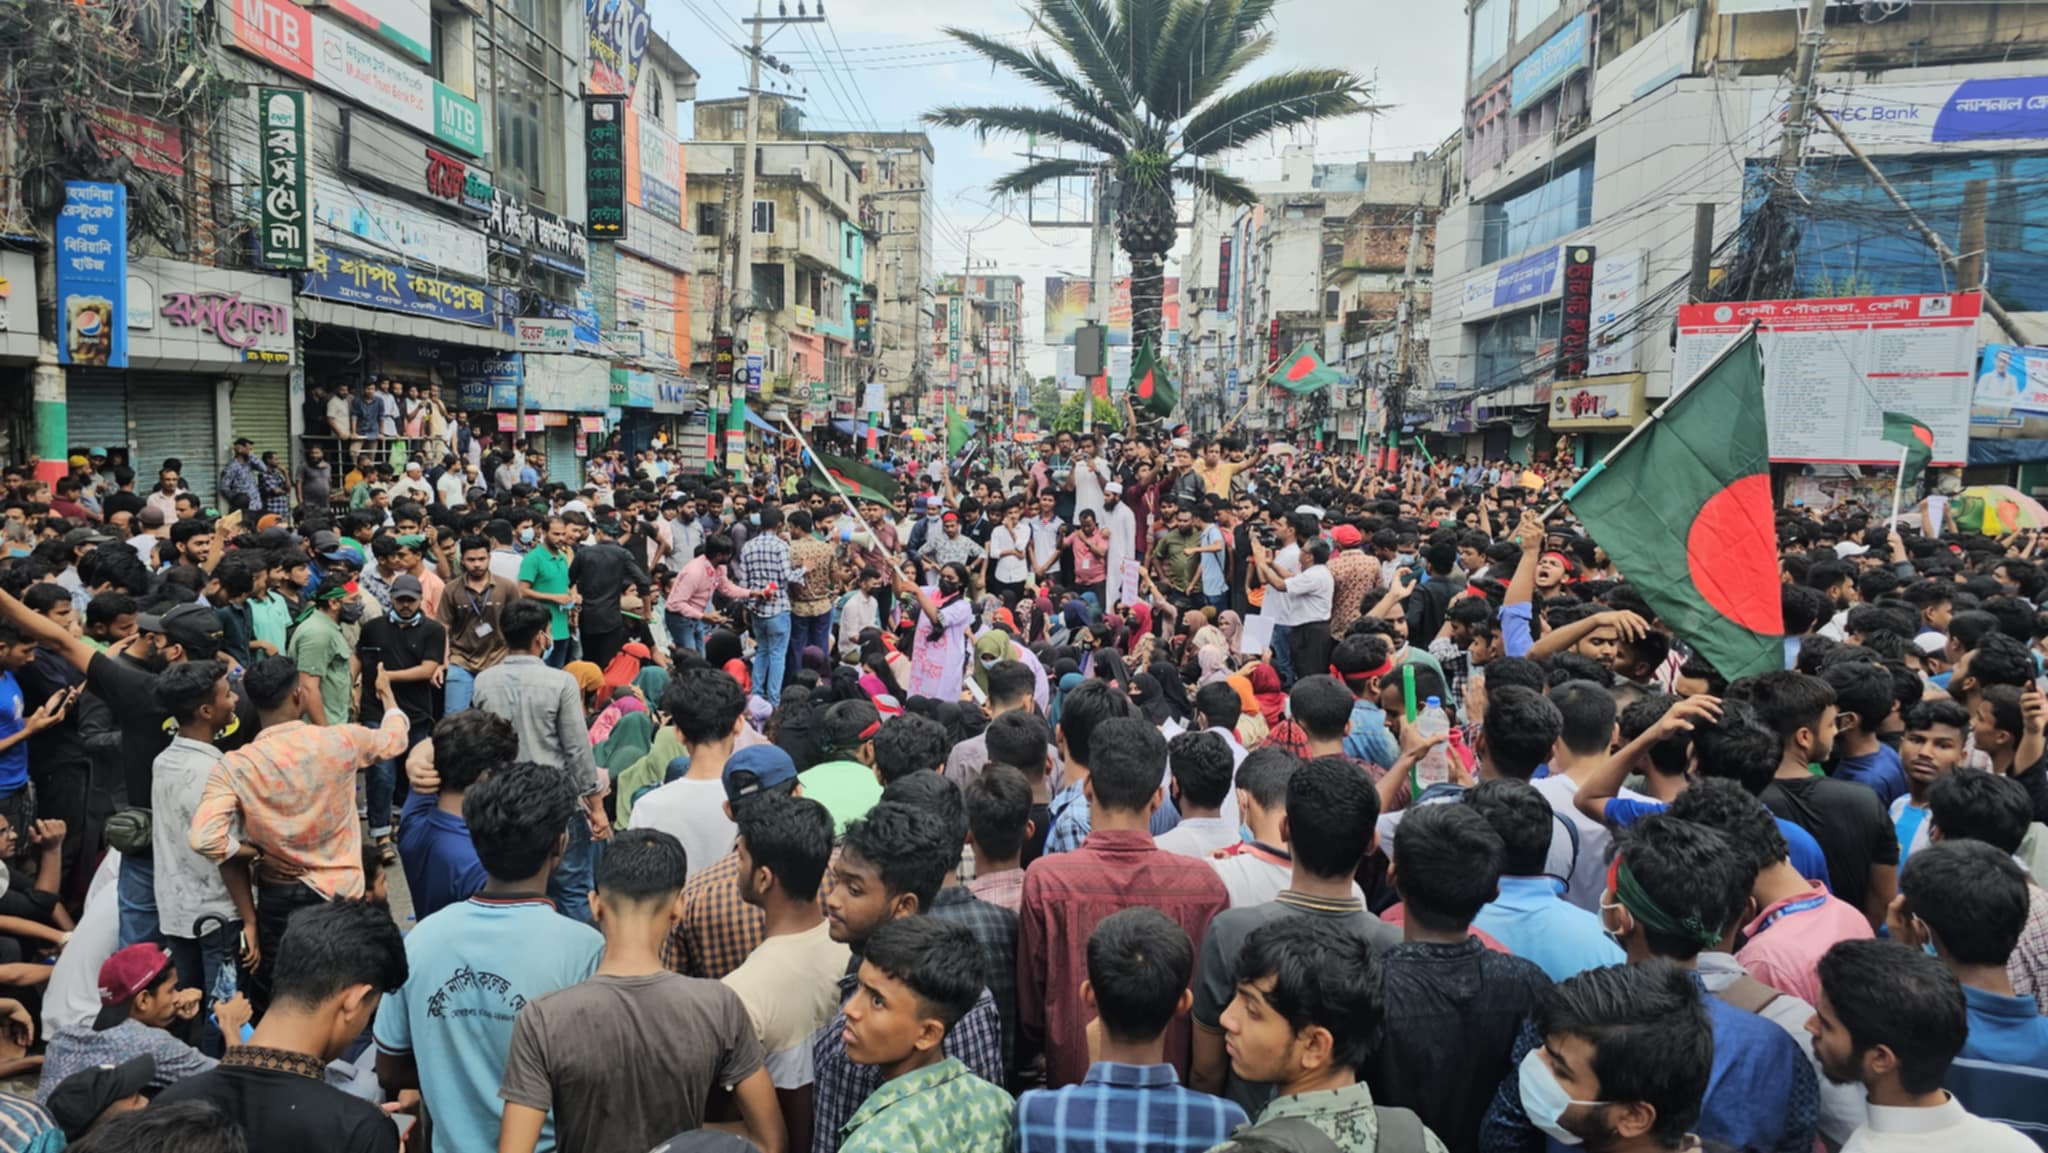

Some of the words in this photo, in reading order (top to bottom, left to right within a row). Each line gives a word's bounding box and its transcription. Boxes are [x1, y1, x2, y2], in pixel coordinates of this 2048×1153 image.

[242, 0, 300, 49] MTB
[441, 95, 476, 137] MTB
[1871, 104, 1919, 120] Bank
[1737, 305, 1777, 317] ফেনী
[1868, 299, 1913, 313] ফেনী
